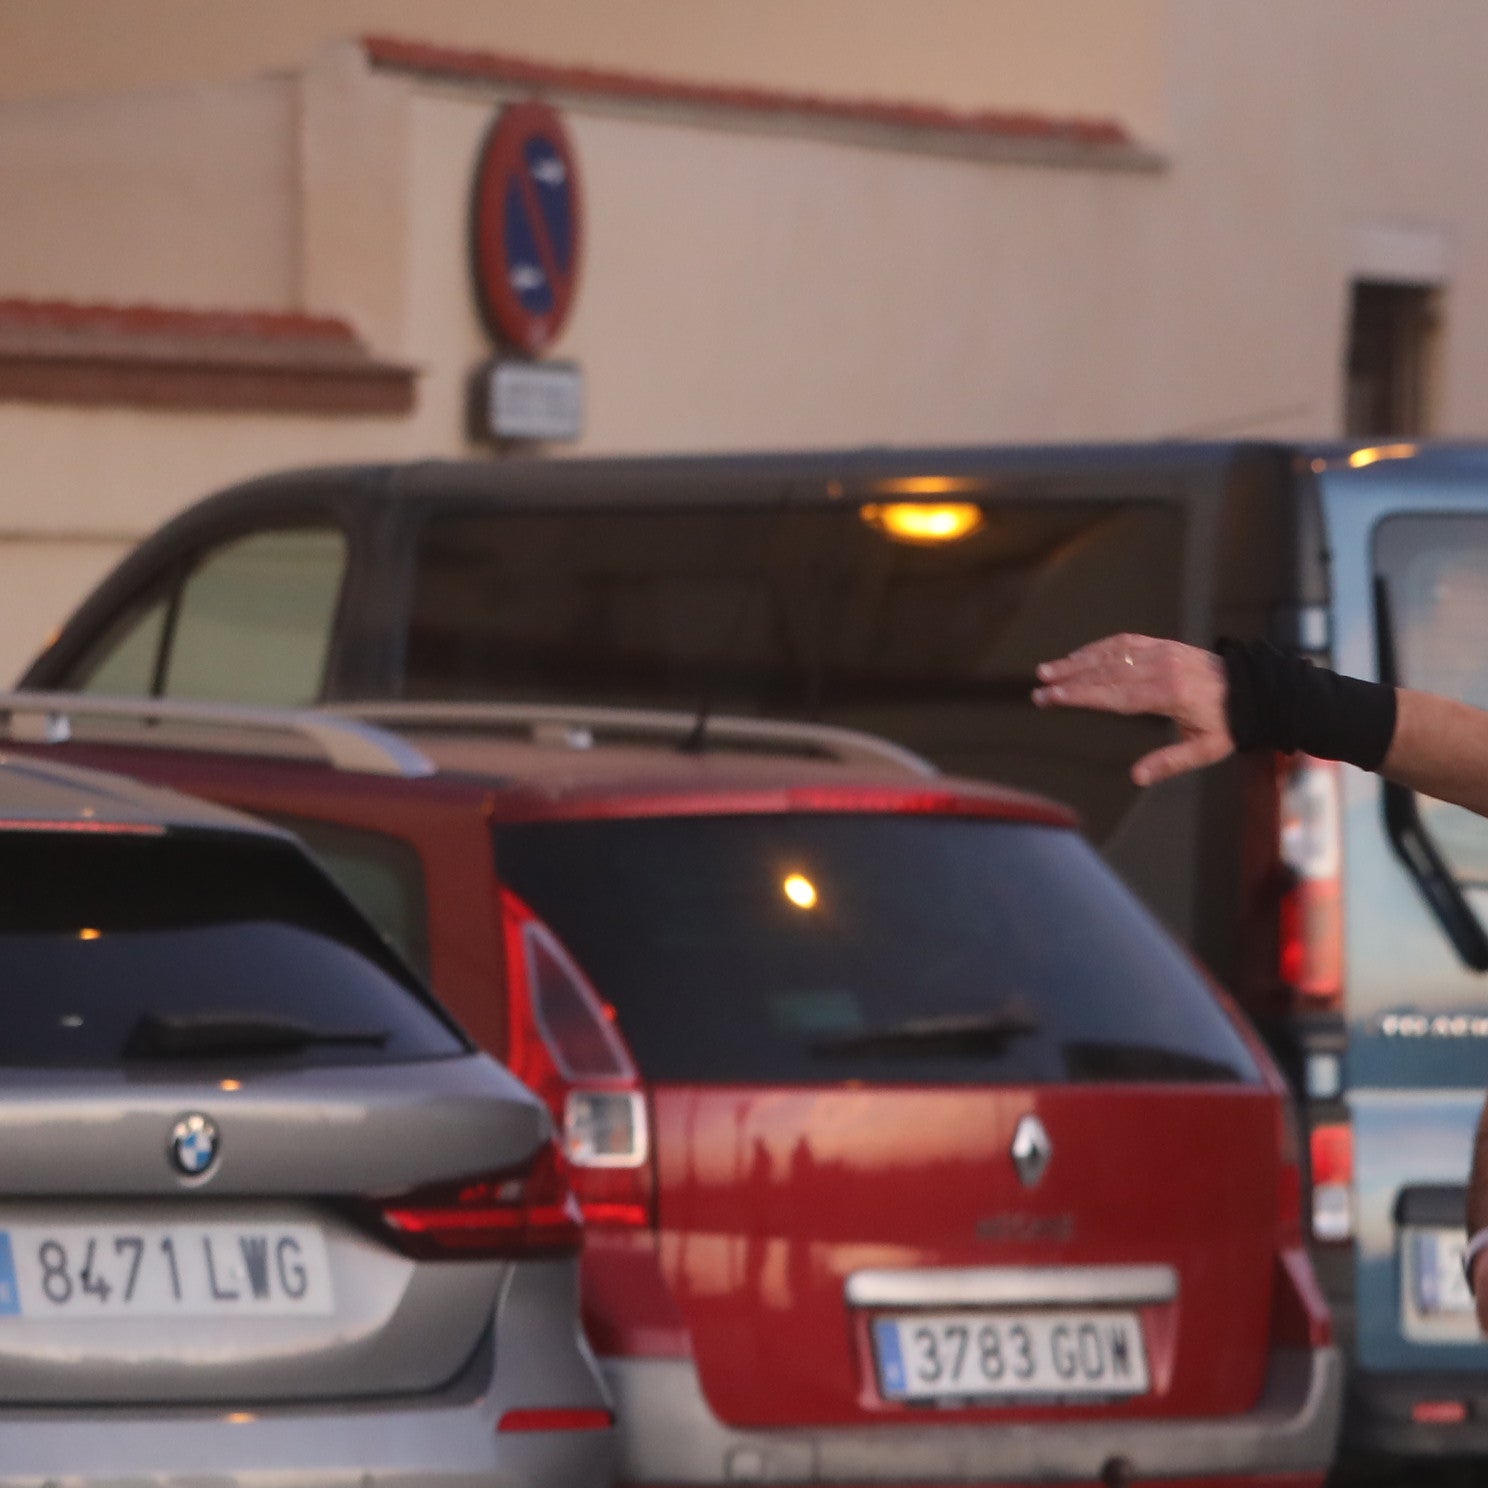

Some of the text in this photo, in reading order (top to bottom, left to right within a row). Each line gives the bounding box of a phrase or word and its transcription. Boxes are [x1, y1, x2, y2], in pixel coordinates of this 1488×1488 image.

[37, 1234, 309, 1305] 8471 LWG
[912, 1321, 1037, 1383] 3783
